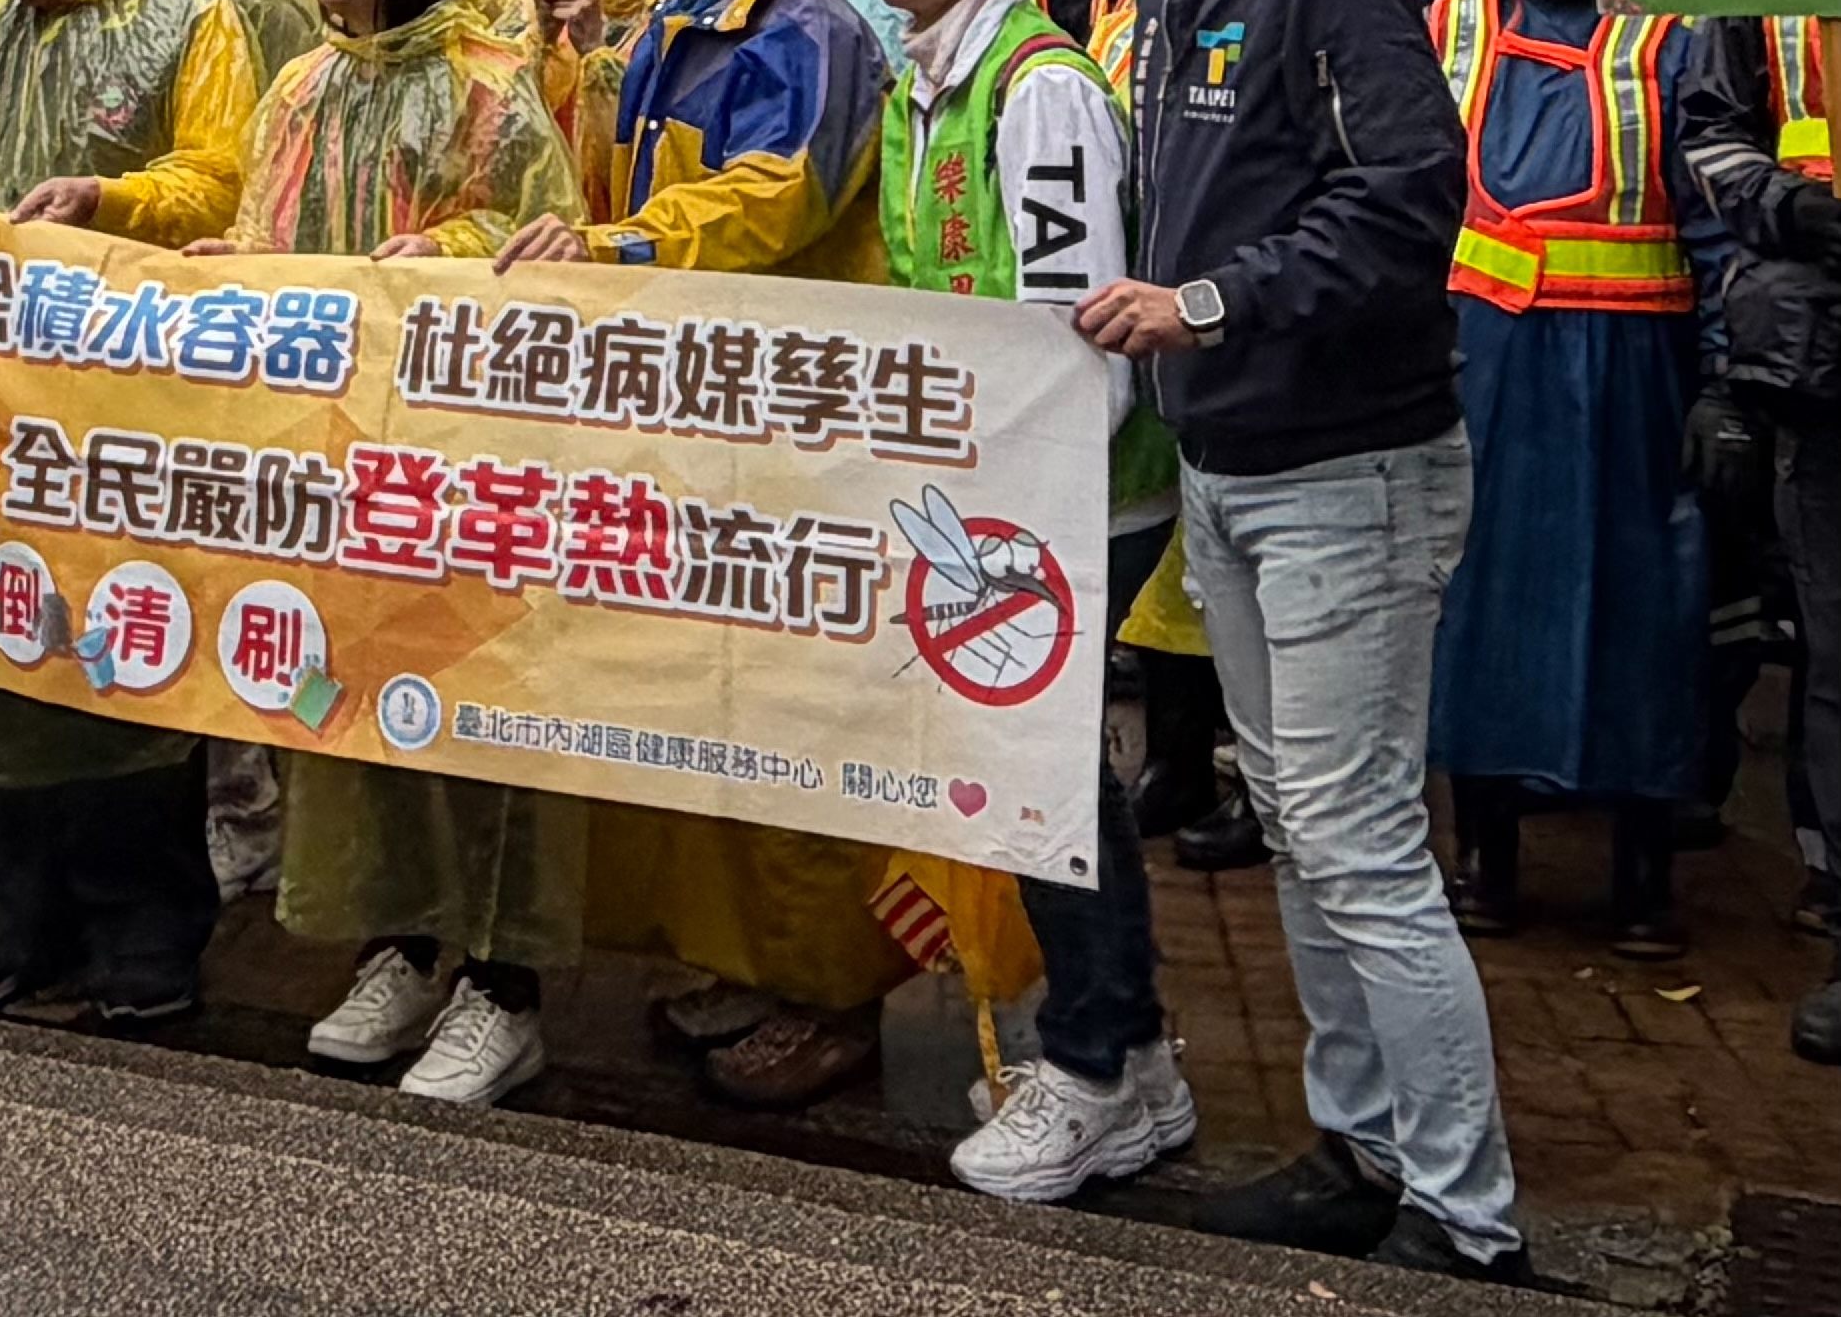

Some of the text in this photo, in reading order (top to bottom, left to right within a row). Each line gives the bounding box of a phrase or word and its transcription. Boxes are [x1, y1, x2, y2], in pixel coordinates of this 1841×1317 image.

[1188, 85, 1236, 108] TAIPEI
[1021, 145, 1089, 306] TAI
[400, 300, 960, 450] 杜絕病媒孳生
[5, 420, 880, 625] 全民嚴防登革熱流行
[104, 582, 172, 667] 清
[231, 603, 302, 686] 刷
[455, 703, 938, 809] 臺北市內湖區健康服務中心 關心您
